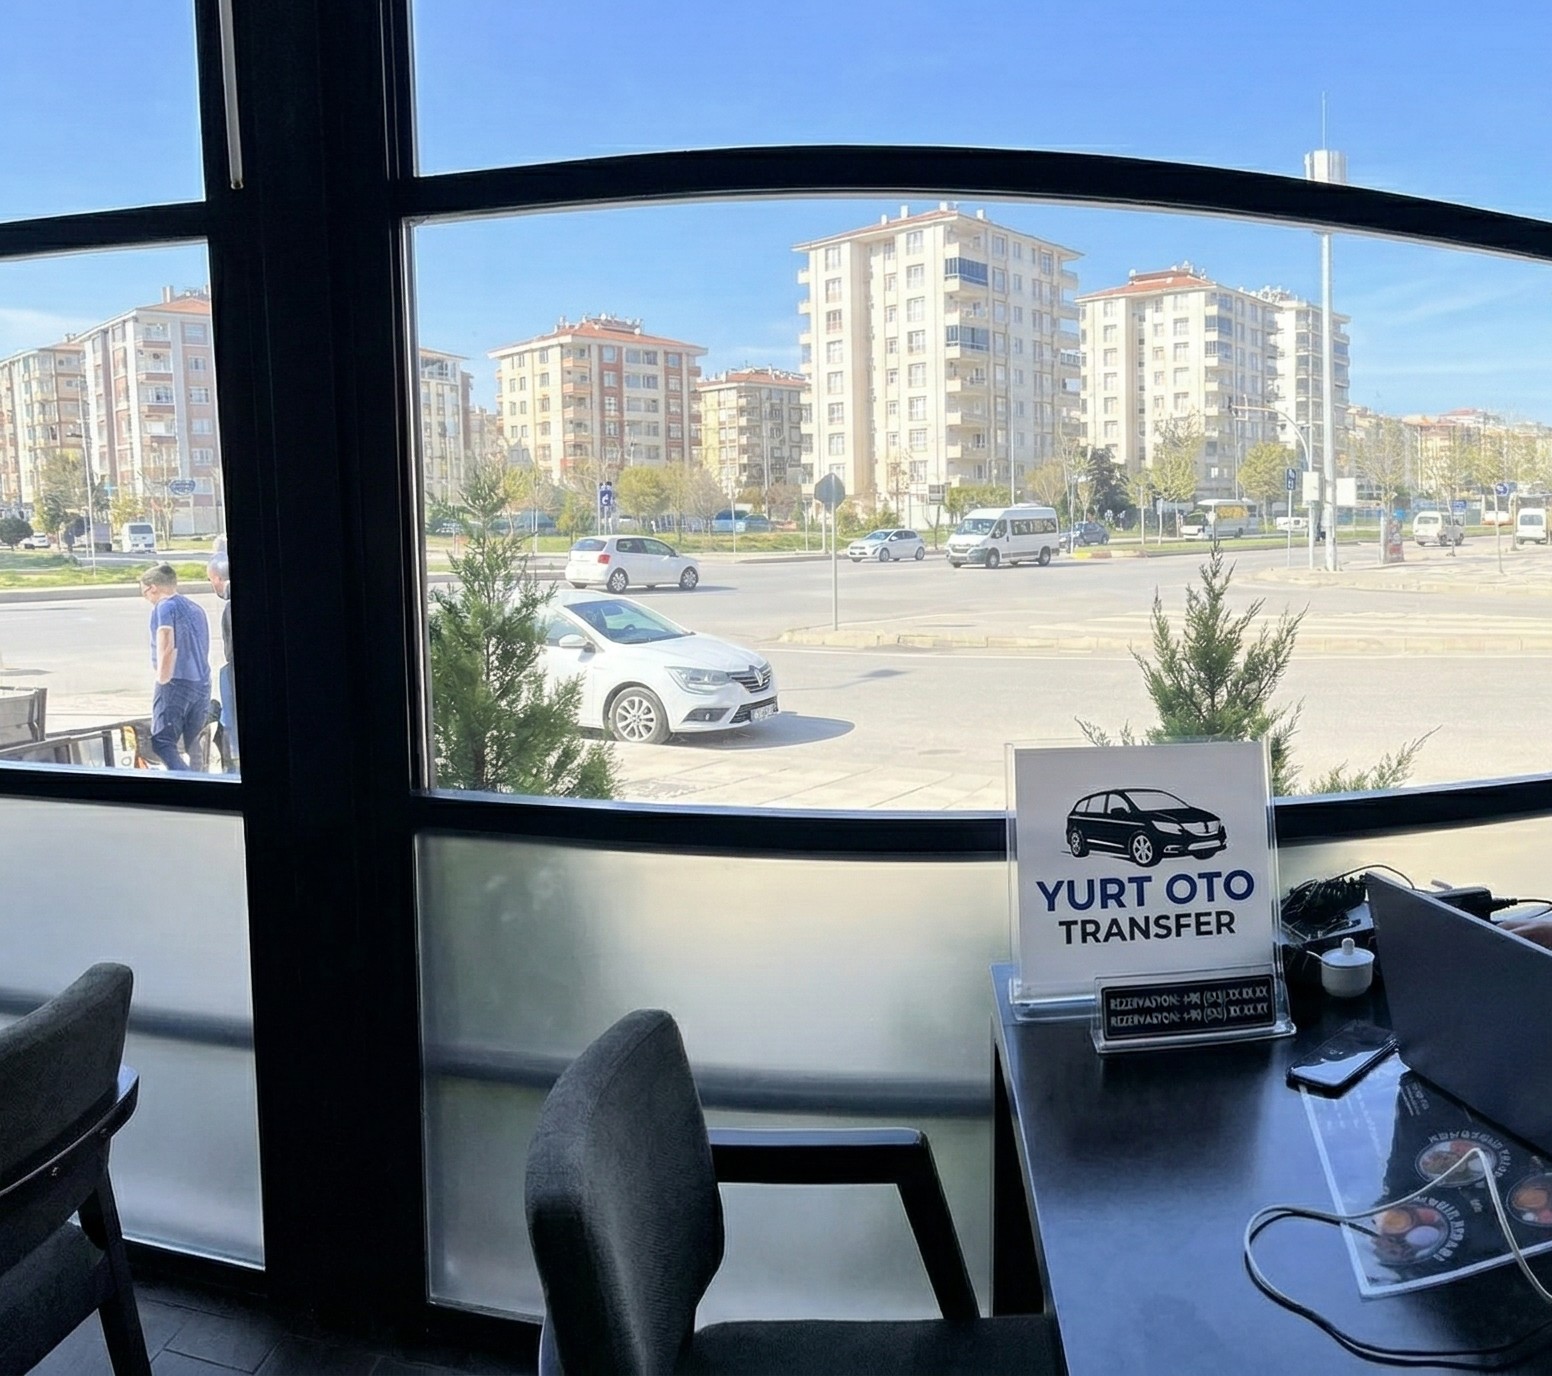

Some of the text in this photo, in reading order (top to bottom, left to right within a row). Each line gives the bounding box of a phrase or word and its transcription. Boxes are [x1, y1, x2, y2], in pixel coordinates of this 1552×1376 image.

[1036, 869, 1254, 912] YURT OTO
[1059, 910, 1235, 945] TRANSFER
